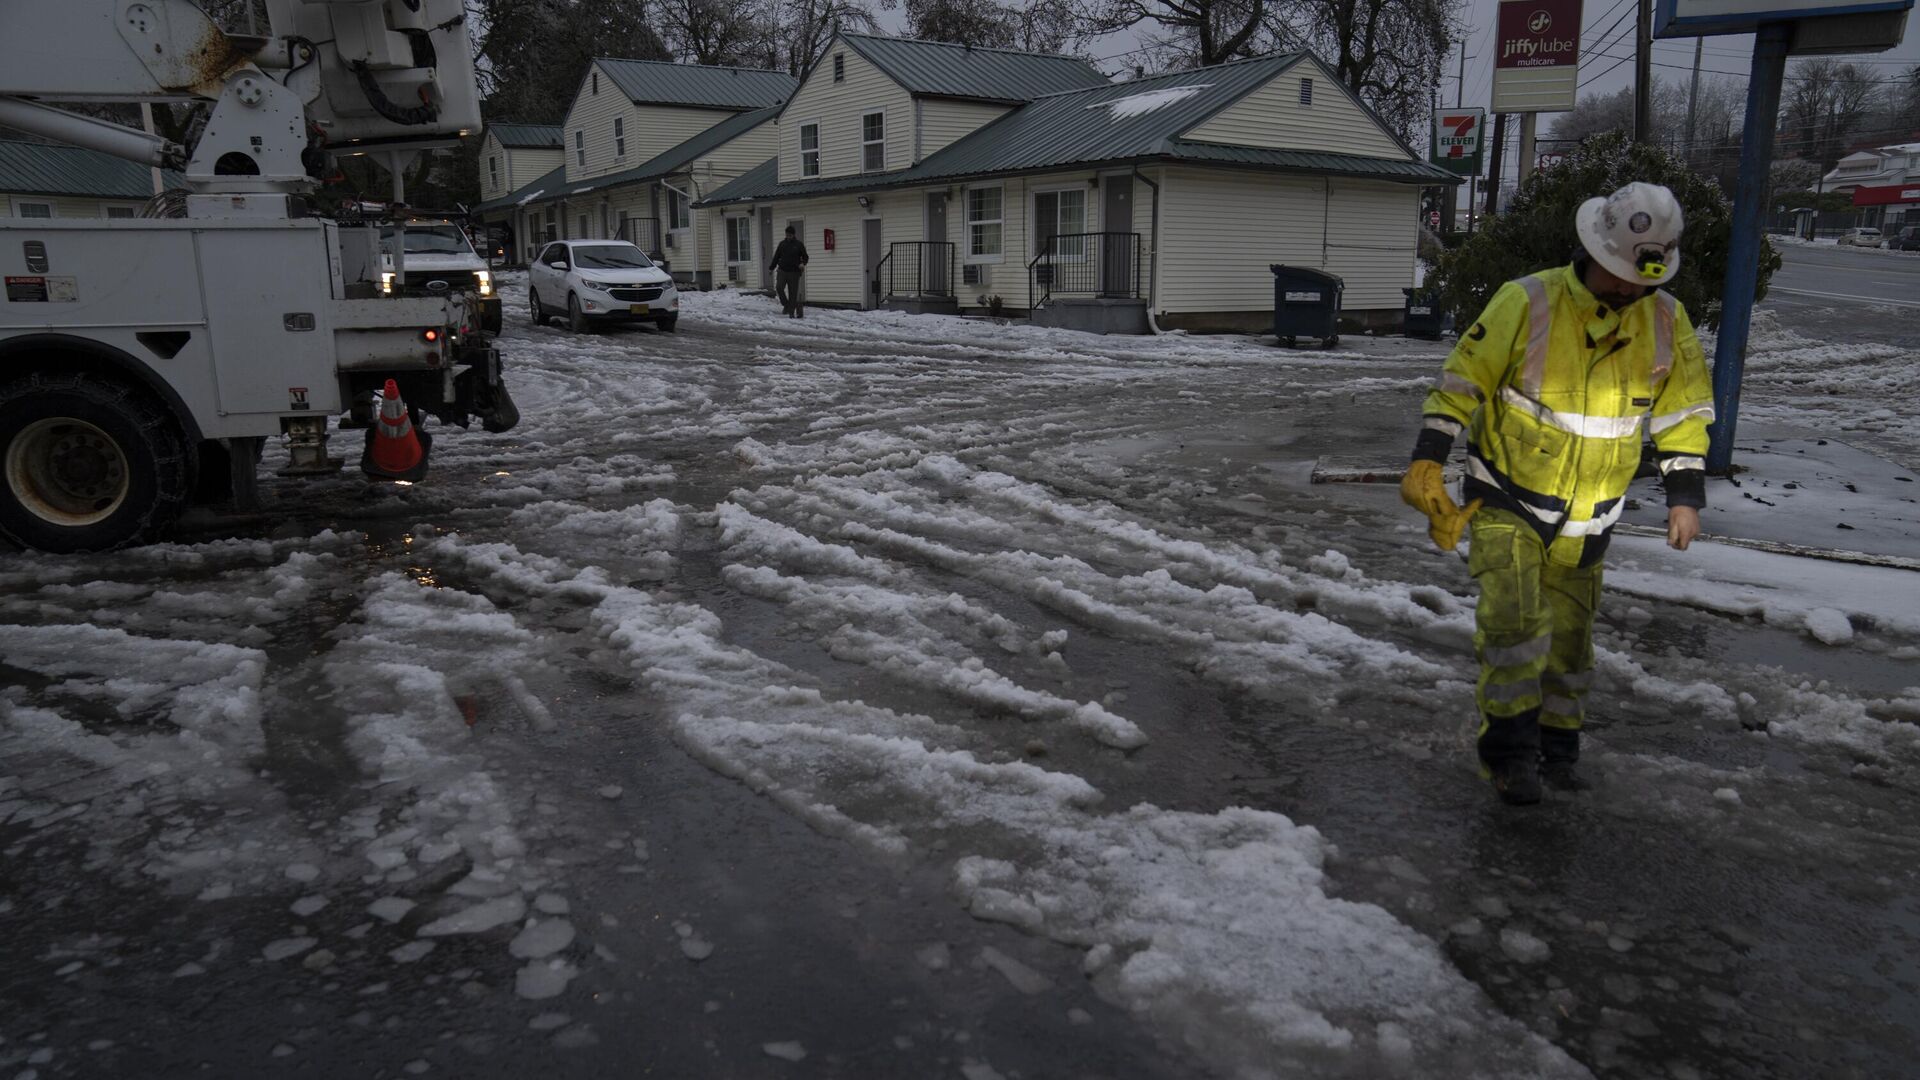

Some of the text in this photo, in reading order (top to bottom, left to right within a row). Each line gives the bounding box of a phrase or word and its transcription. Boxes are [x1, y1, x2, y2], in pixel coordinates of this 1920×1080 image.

[1503, 37, 1573, 58] jiffy lube
[1517, 58, 1556, 67] multicare
[1443, 116, 1475, 159] 7
